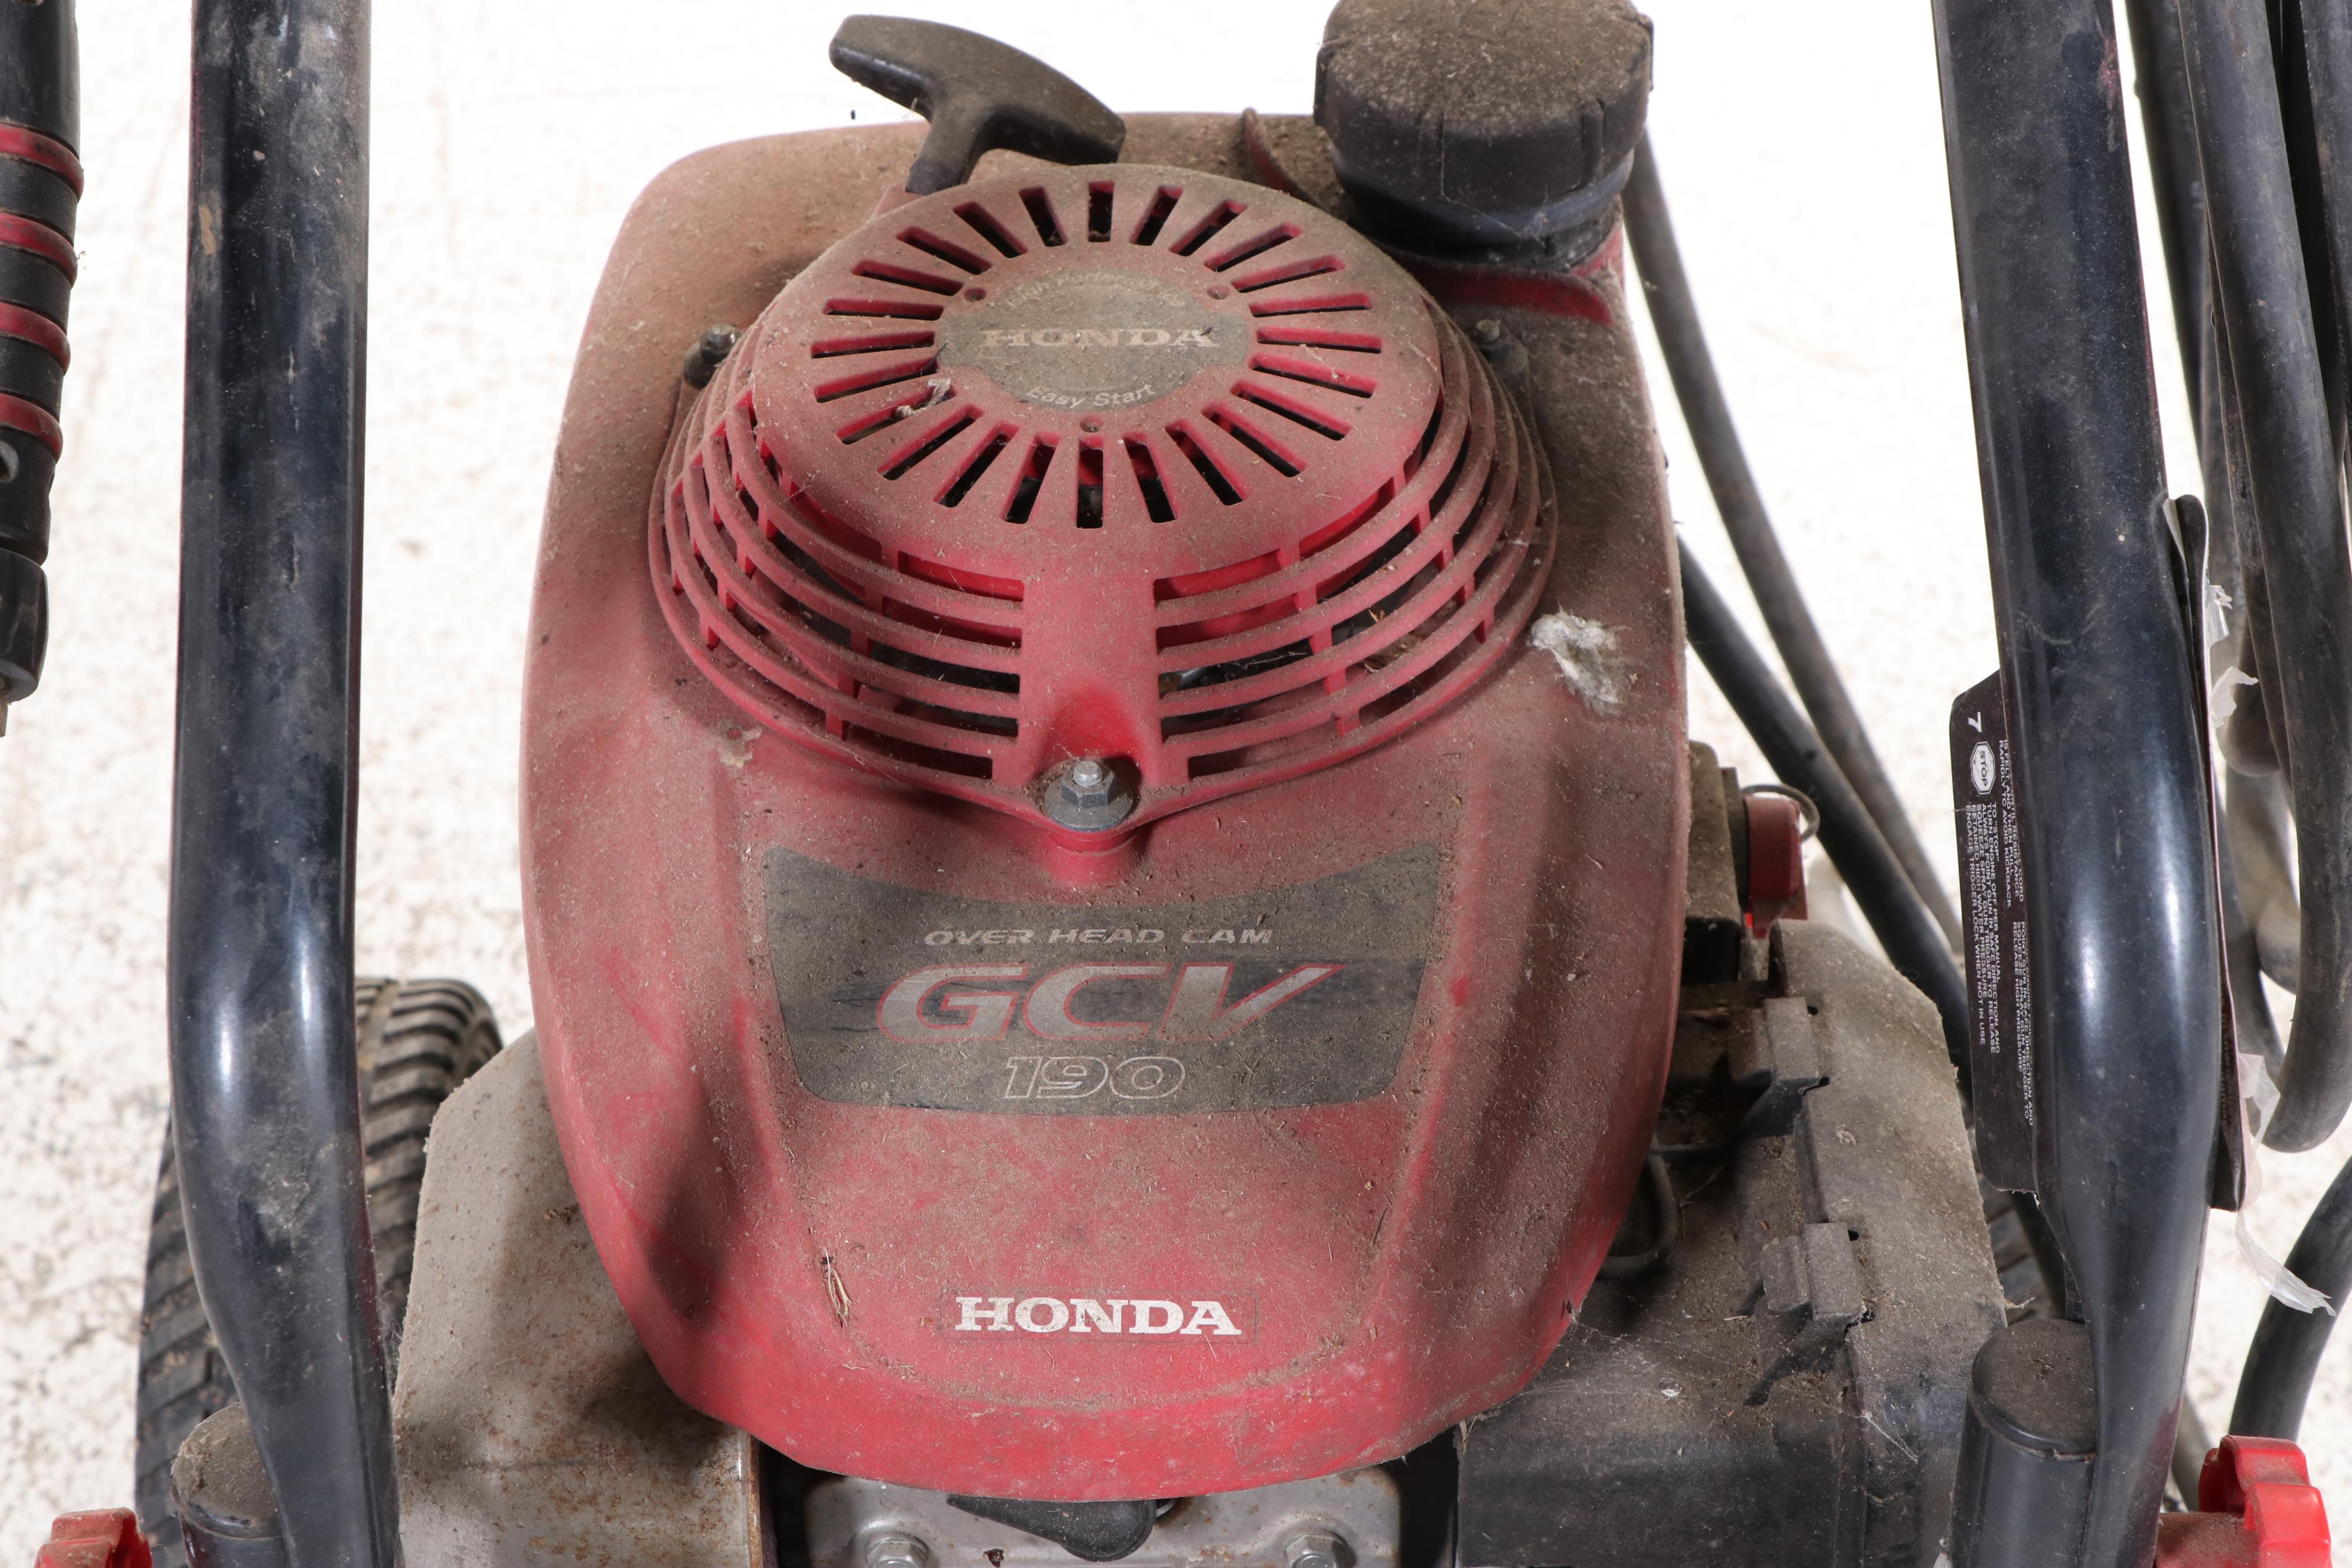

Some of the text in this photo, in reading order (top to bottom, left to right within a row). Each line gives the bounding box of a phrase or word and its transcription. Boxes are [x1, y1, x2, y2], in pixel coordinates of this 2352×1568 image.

[981, 328, 1219, 347] HONDA
[1026, 383, 1155, 409] Easy Start
[1968, 712, 1981, 733] 7
[2004, 739, 2007, 750] IS
[2001, 792, 2006, 806] TO
[1992, 802, 1996, 818] TO
[1965, 805, 1974, 852] ENGAGE
[1979, 1008, 1984, 1019] IN
[1988, 918, 1993, 928] IN
[924, 928, 1274, 946] OVER HEAD CAM
[1979, 937, 1987, 999] PRESSURE
[1987, 982, 1992, 998] TO
[2023, 988, 2027, 998] IN
[875, 962, 1346, 1044] GCV
[1004, 1054, 1186, 1100] 190
[2024, 1104, 2028, 1119] TO
[955, 1296, 1242, 1335] HONDA
